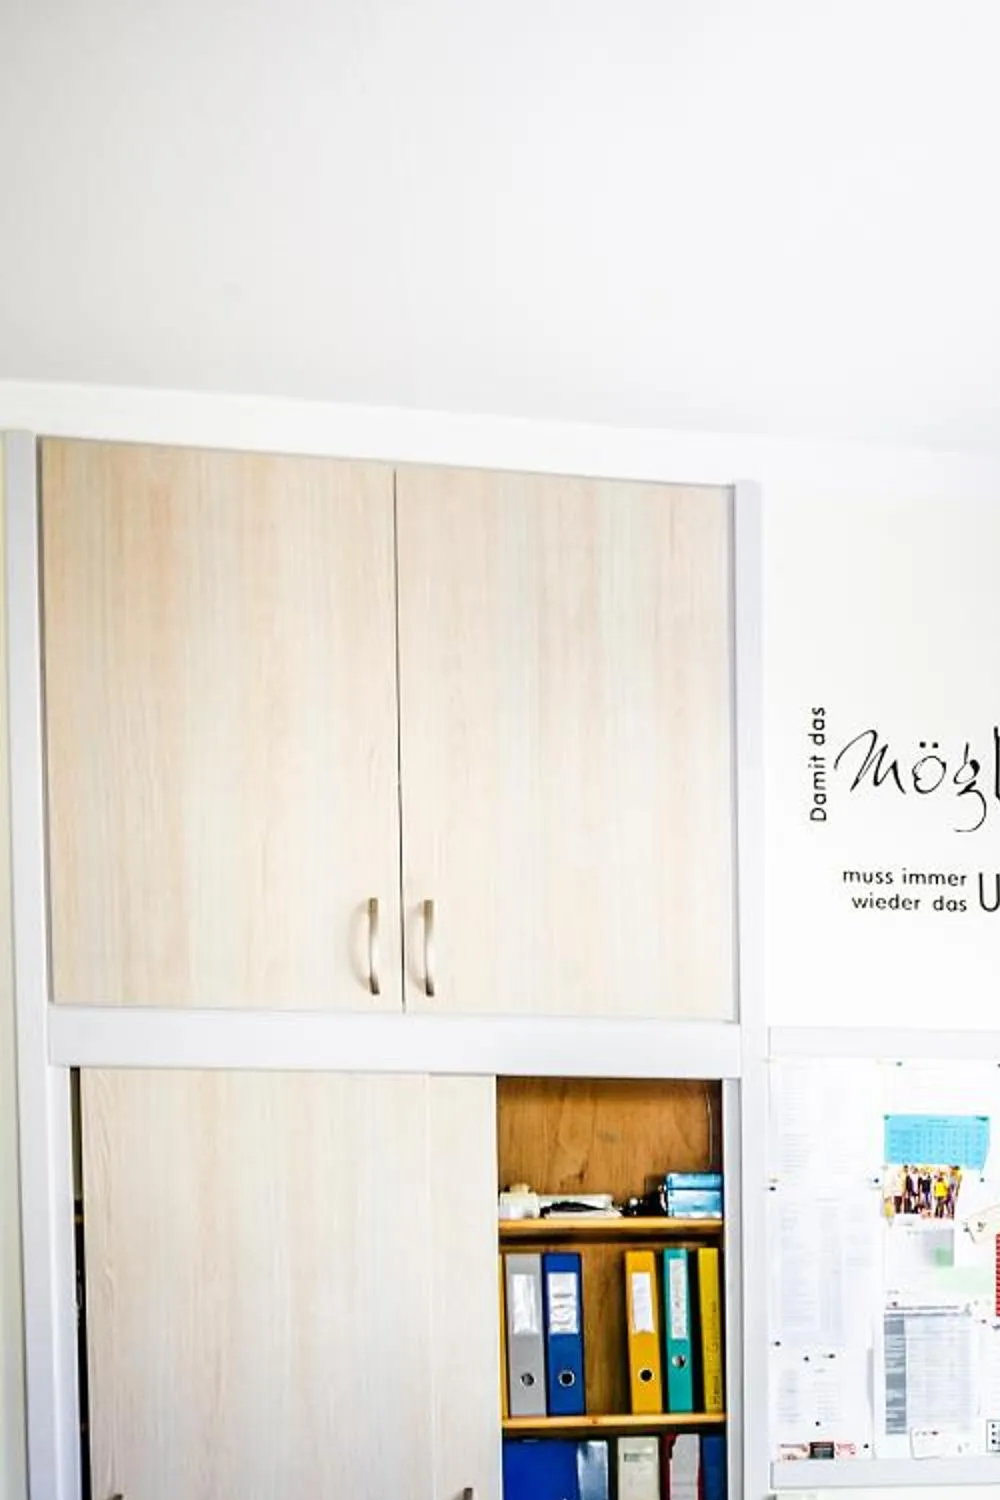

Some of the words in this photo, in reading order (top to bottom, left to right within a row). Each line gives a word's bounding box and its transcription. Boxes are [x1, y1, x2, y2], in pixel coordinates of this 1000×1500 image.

[807, 706, 826, 746] das
[808, 755, 827, 822] Damit
[842, 869, 894, 886] muss
[902, 867, 967, 887] immer
[850, 892, 921, 912] wieder
[932, 894, 968, 913] das
